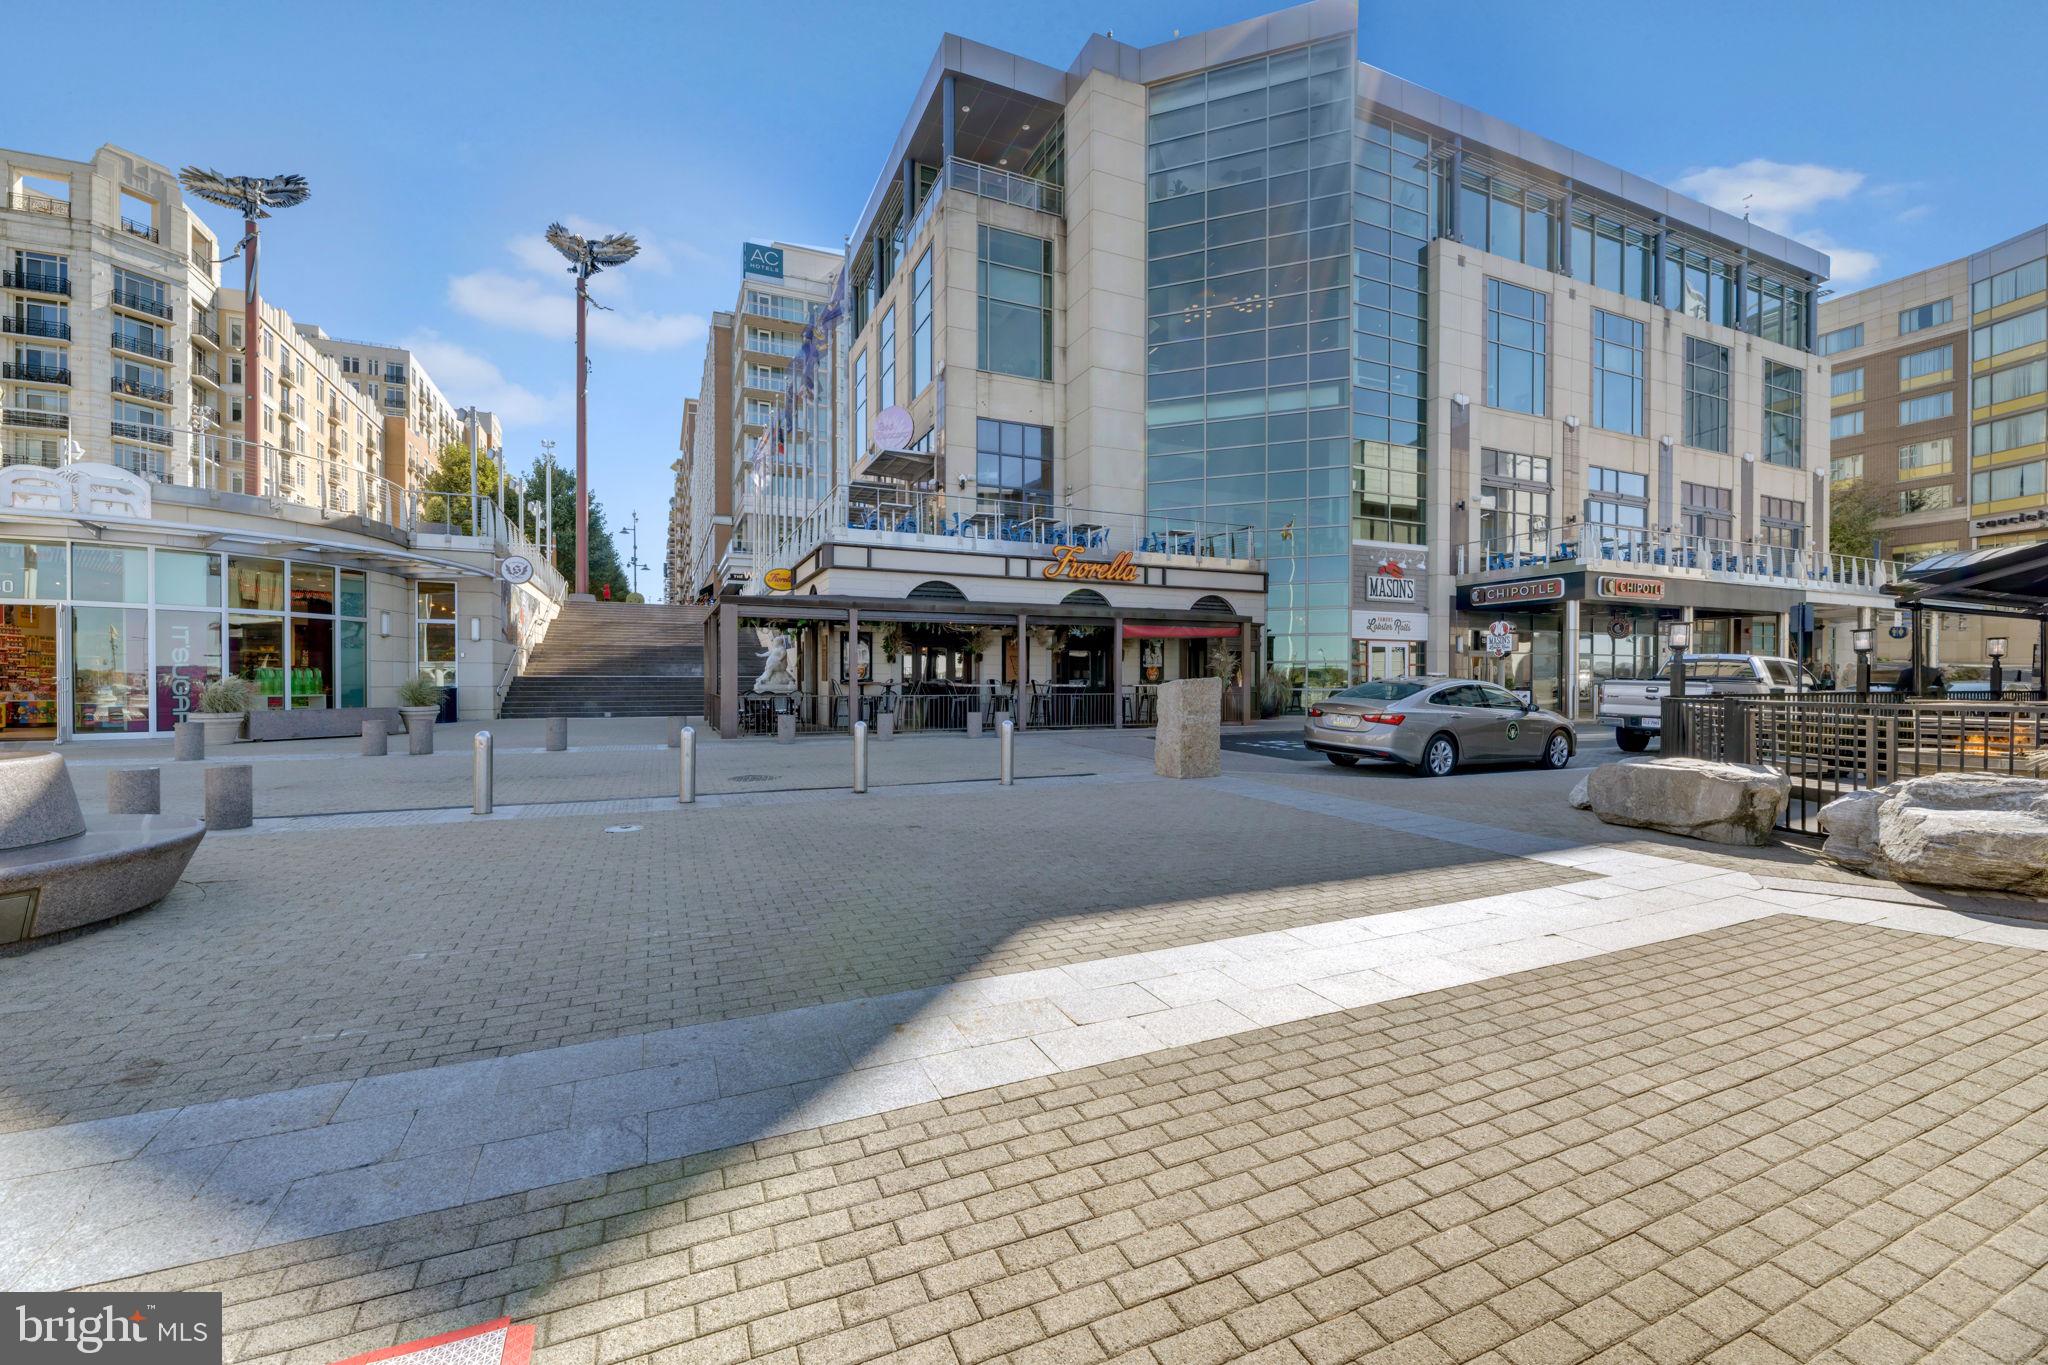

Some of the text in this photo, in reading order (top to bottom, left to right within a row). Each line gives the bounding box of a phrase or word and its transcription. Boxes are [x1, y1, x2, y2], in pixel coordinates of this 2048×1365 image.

[751, 249, 778, 265] AC
[750, 263, 779, 272] HOTELS
[1043, 545, 1138, 581] Fiorella
[1487, 582, 1555, 599] CHIPOTLE
[1620, 582, 1665, 595] CHIPOTLE
